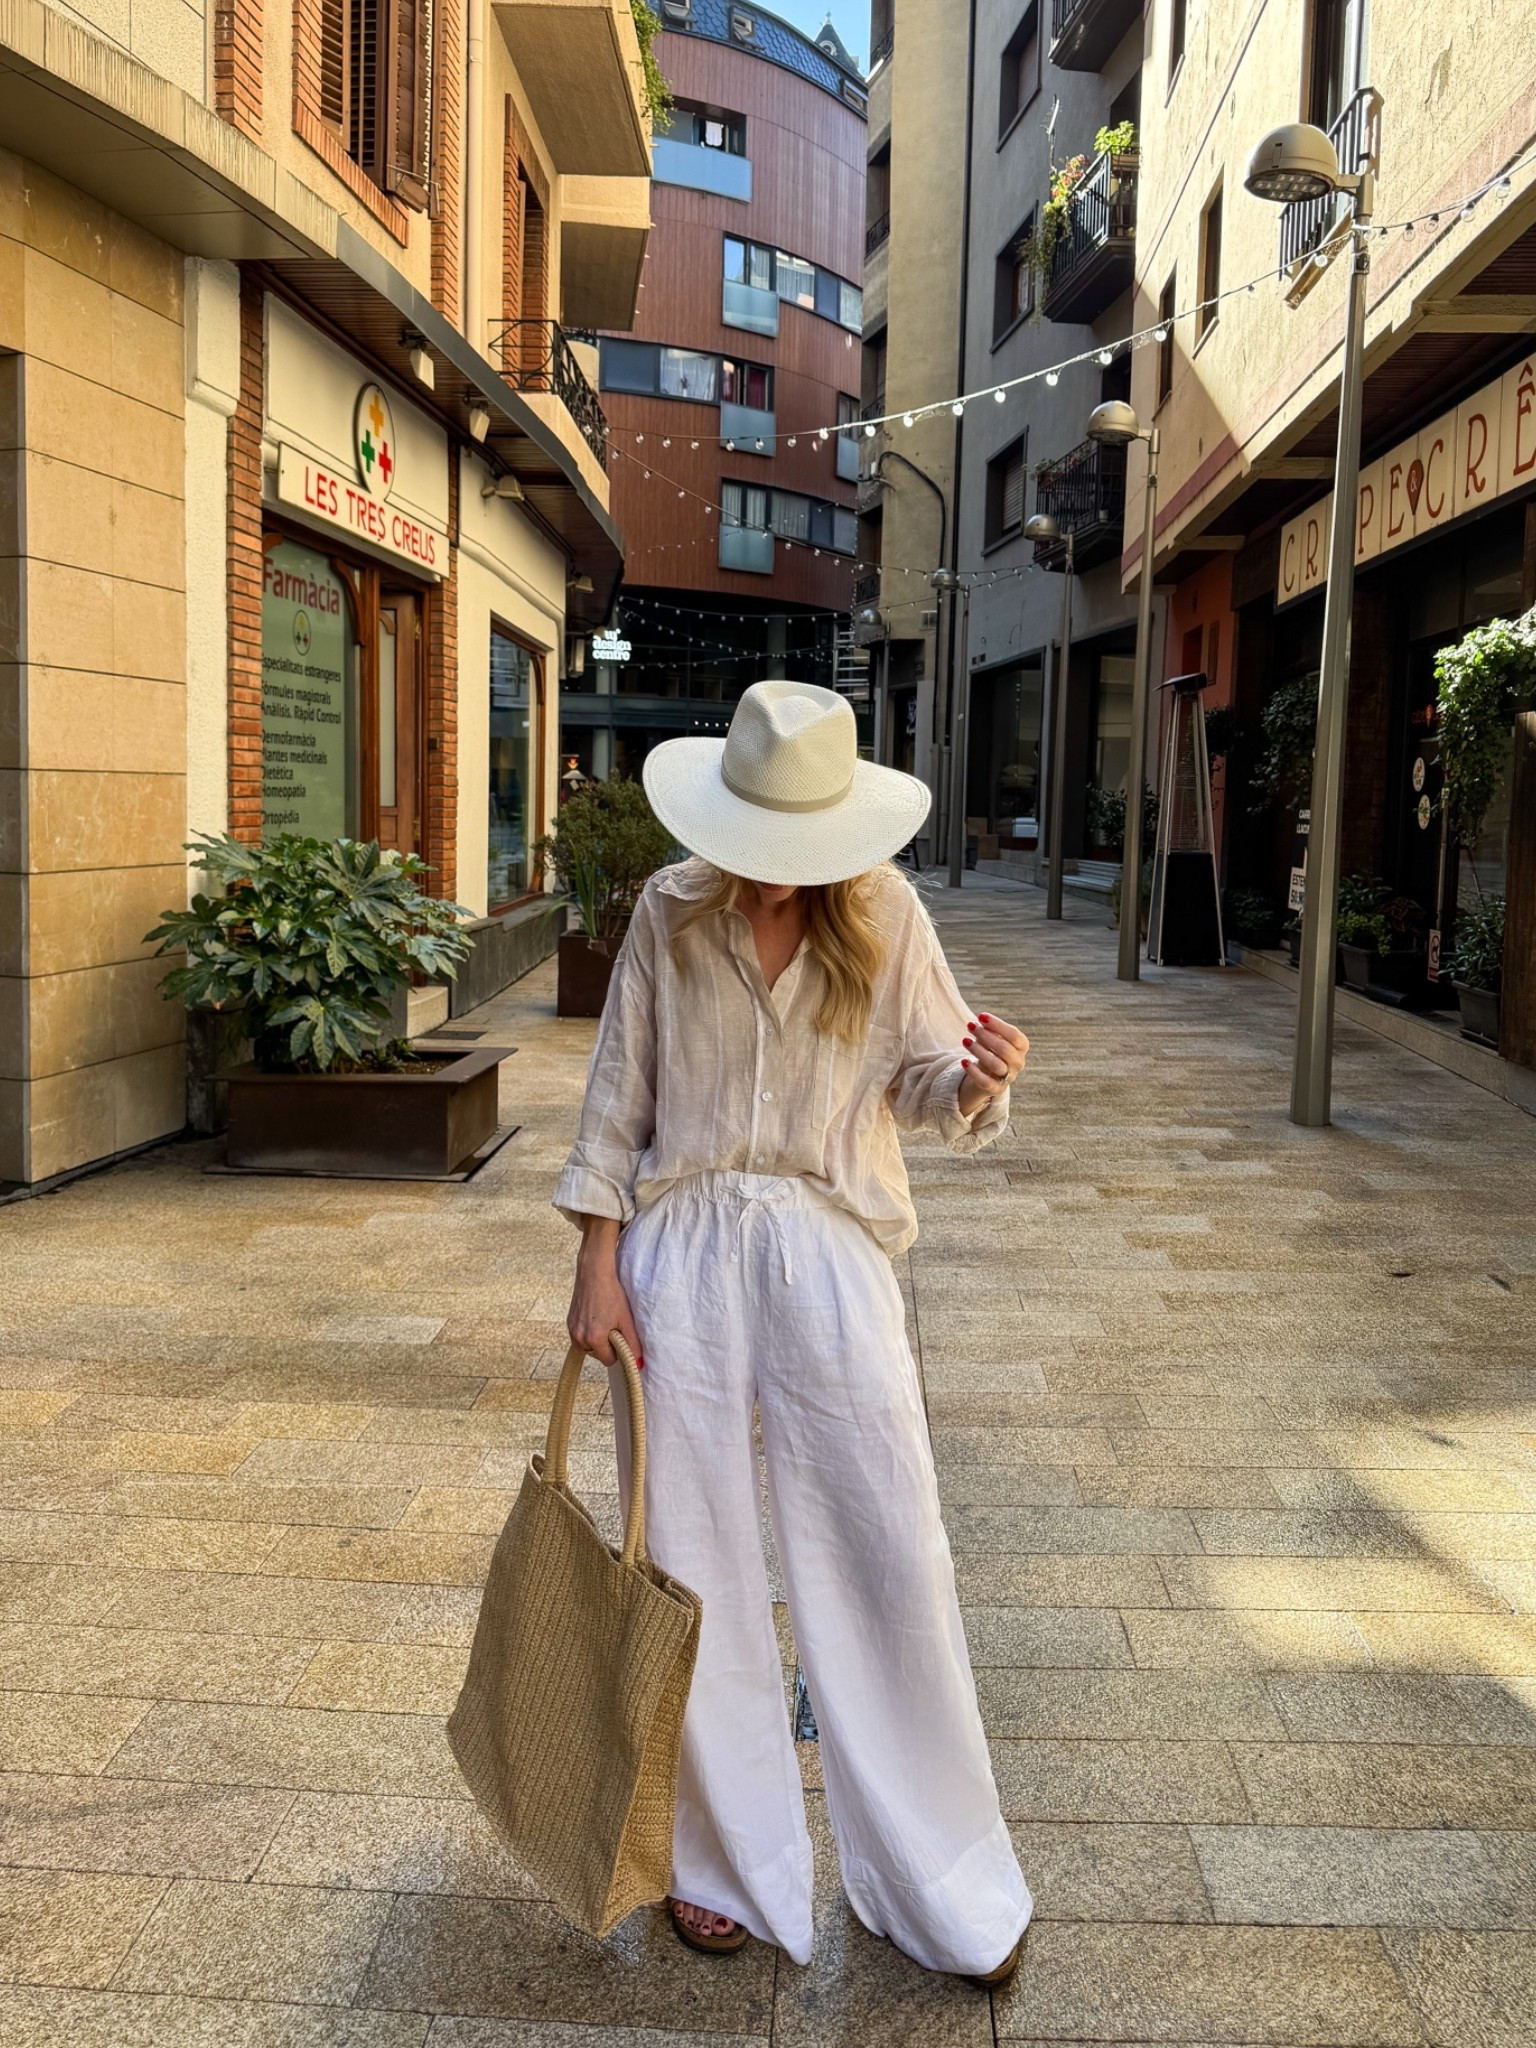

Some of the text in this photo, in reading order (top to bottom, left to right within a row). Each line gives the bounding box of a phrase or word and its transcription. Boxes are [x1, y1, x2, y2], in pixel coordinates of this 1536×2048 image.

[305, 466, 435, 565] LES TRES CREUS
[1283, 463, 1406, 592] CRPE
[262, 556, 340, 616] Farmàcia
[316, 708, 341, 725] Control
